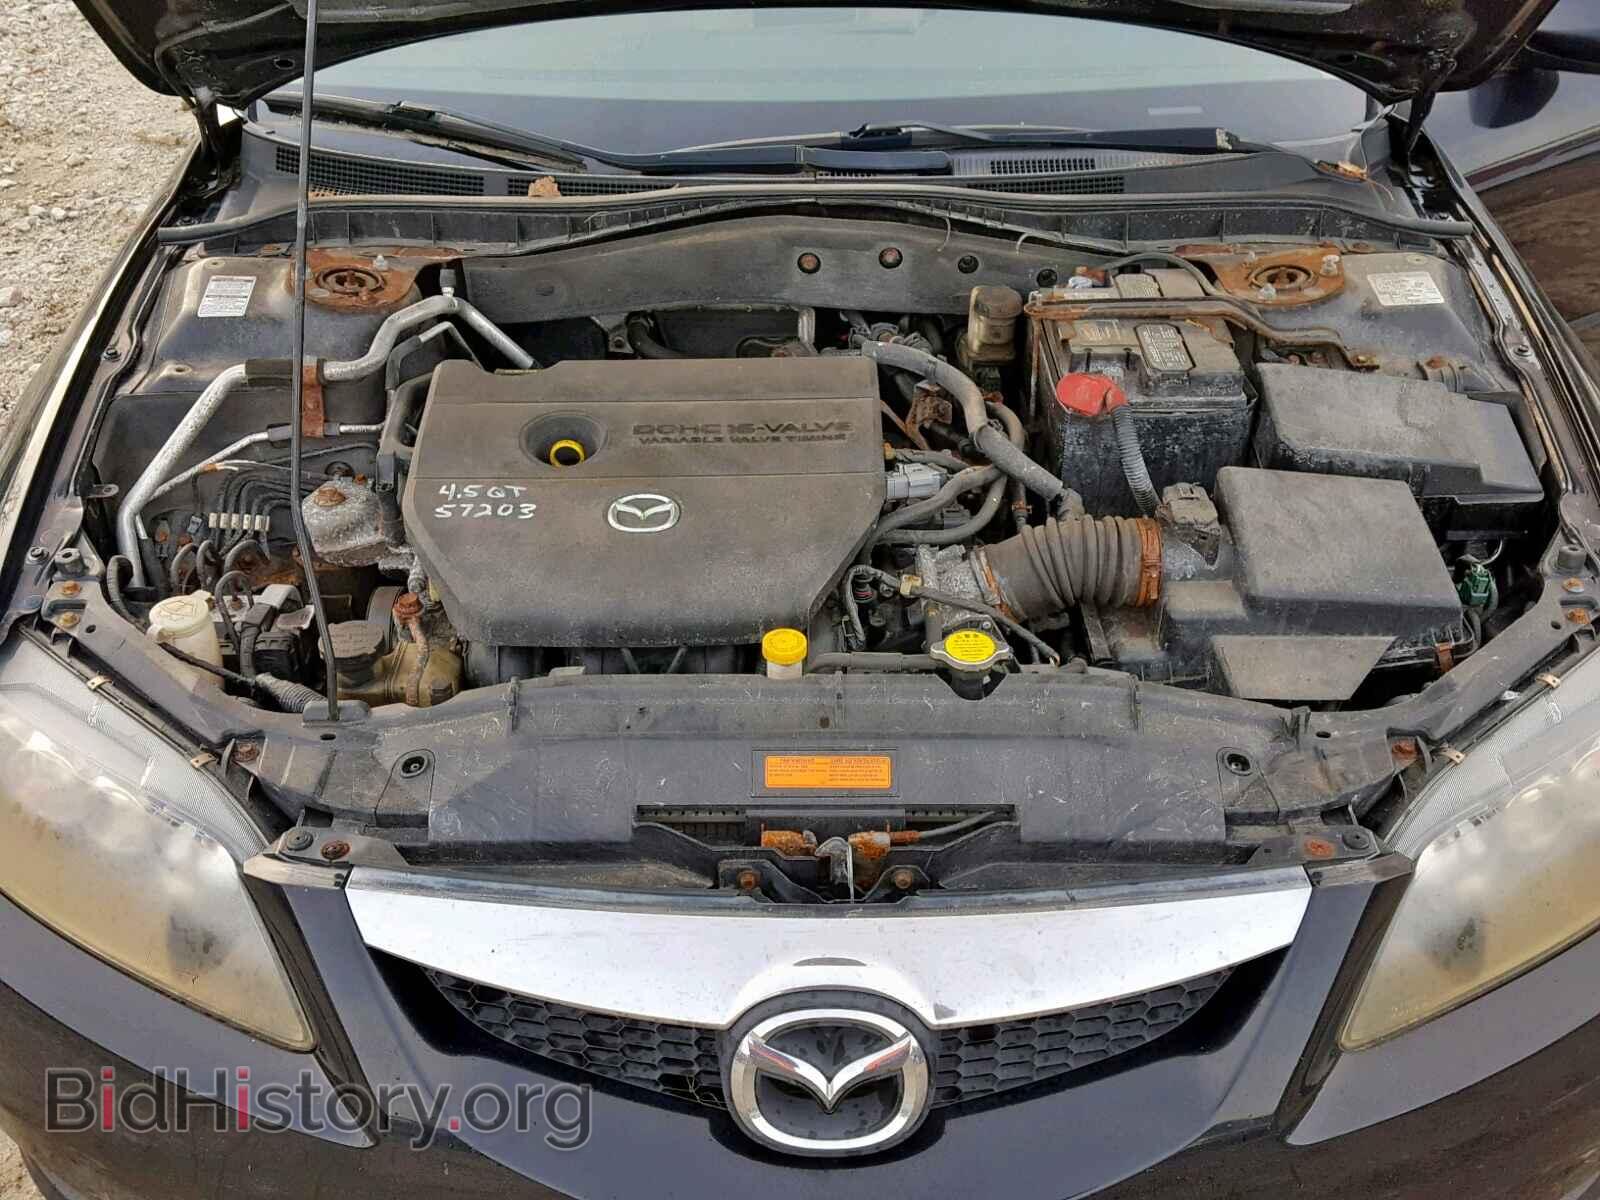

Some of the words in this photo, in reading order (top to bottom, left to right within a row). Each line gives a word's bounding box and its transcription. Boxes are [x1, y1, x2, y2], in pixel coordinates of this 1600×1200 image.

[632, 423, 722, 435] DOHC
[727, 421, 853, 433] 16-VALVE
[434, 503, 537, 519] 57203
